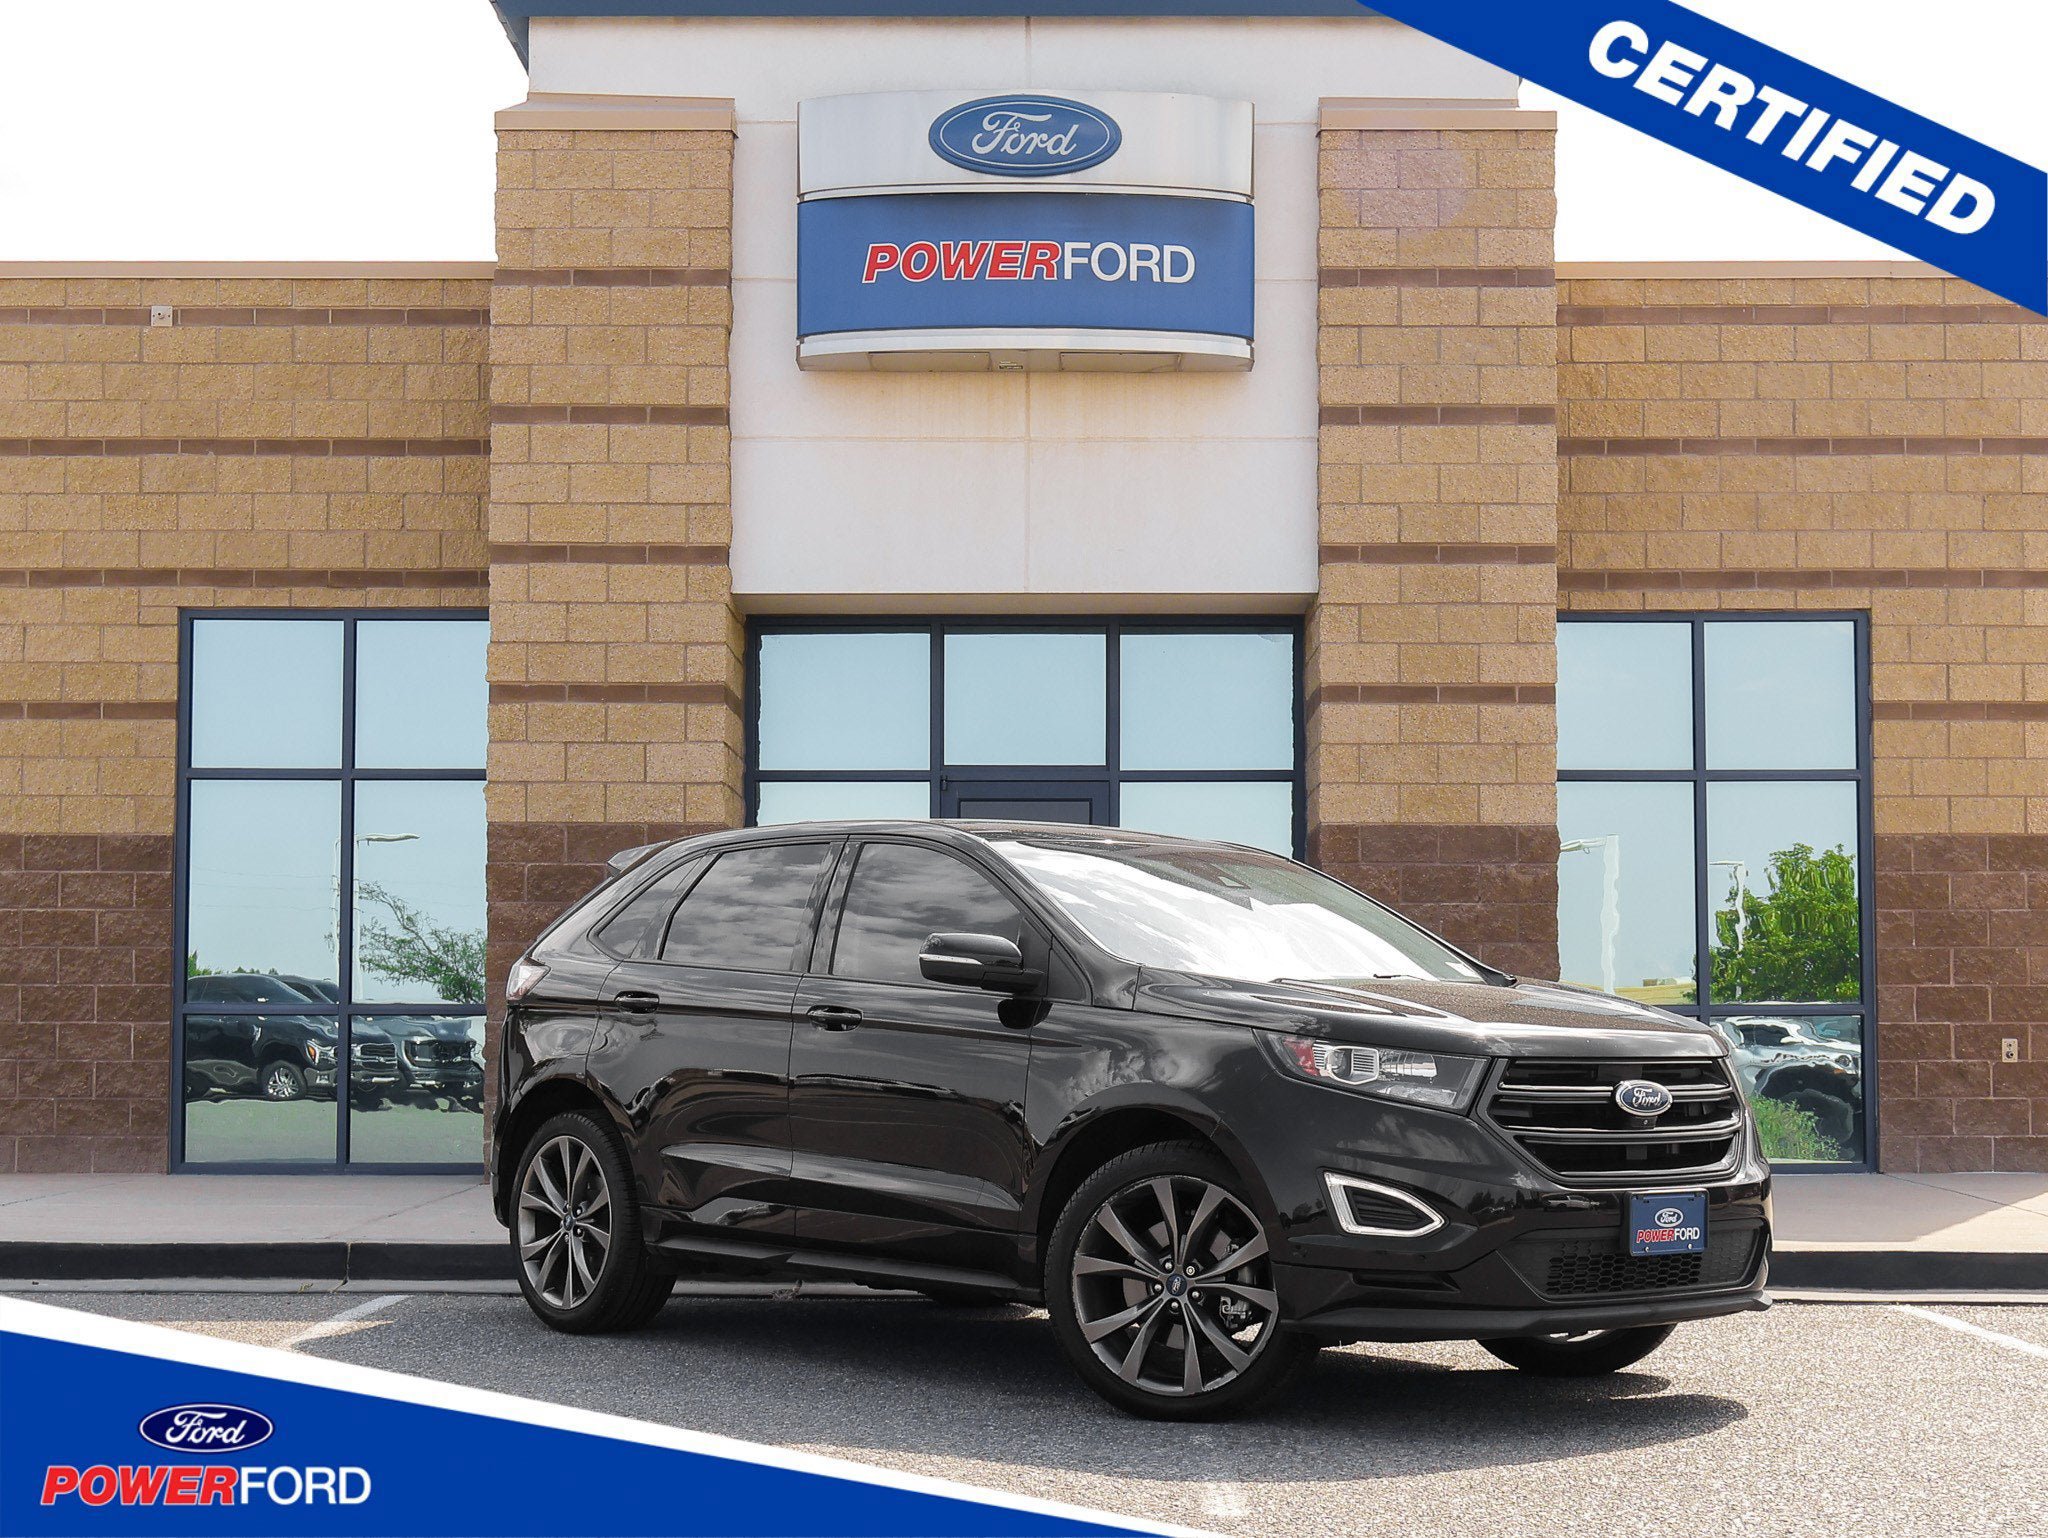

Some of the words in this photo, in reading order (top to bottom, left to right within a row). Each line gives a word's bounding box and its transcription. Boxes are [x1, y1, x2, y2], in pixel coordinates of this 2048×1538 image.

[972, 111, 1079, 156] Ford
[1632, 1087, 1662, 1107] Ford
[1660, 1211, 1678, 1224] Ford
